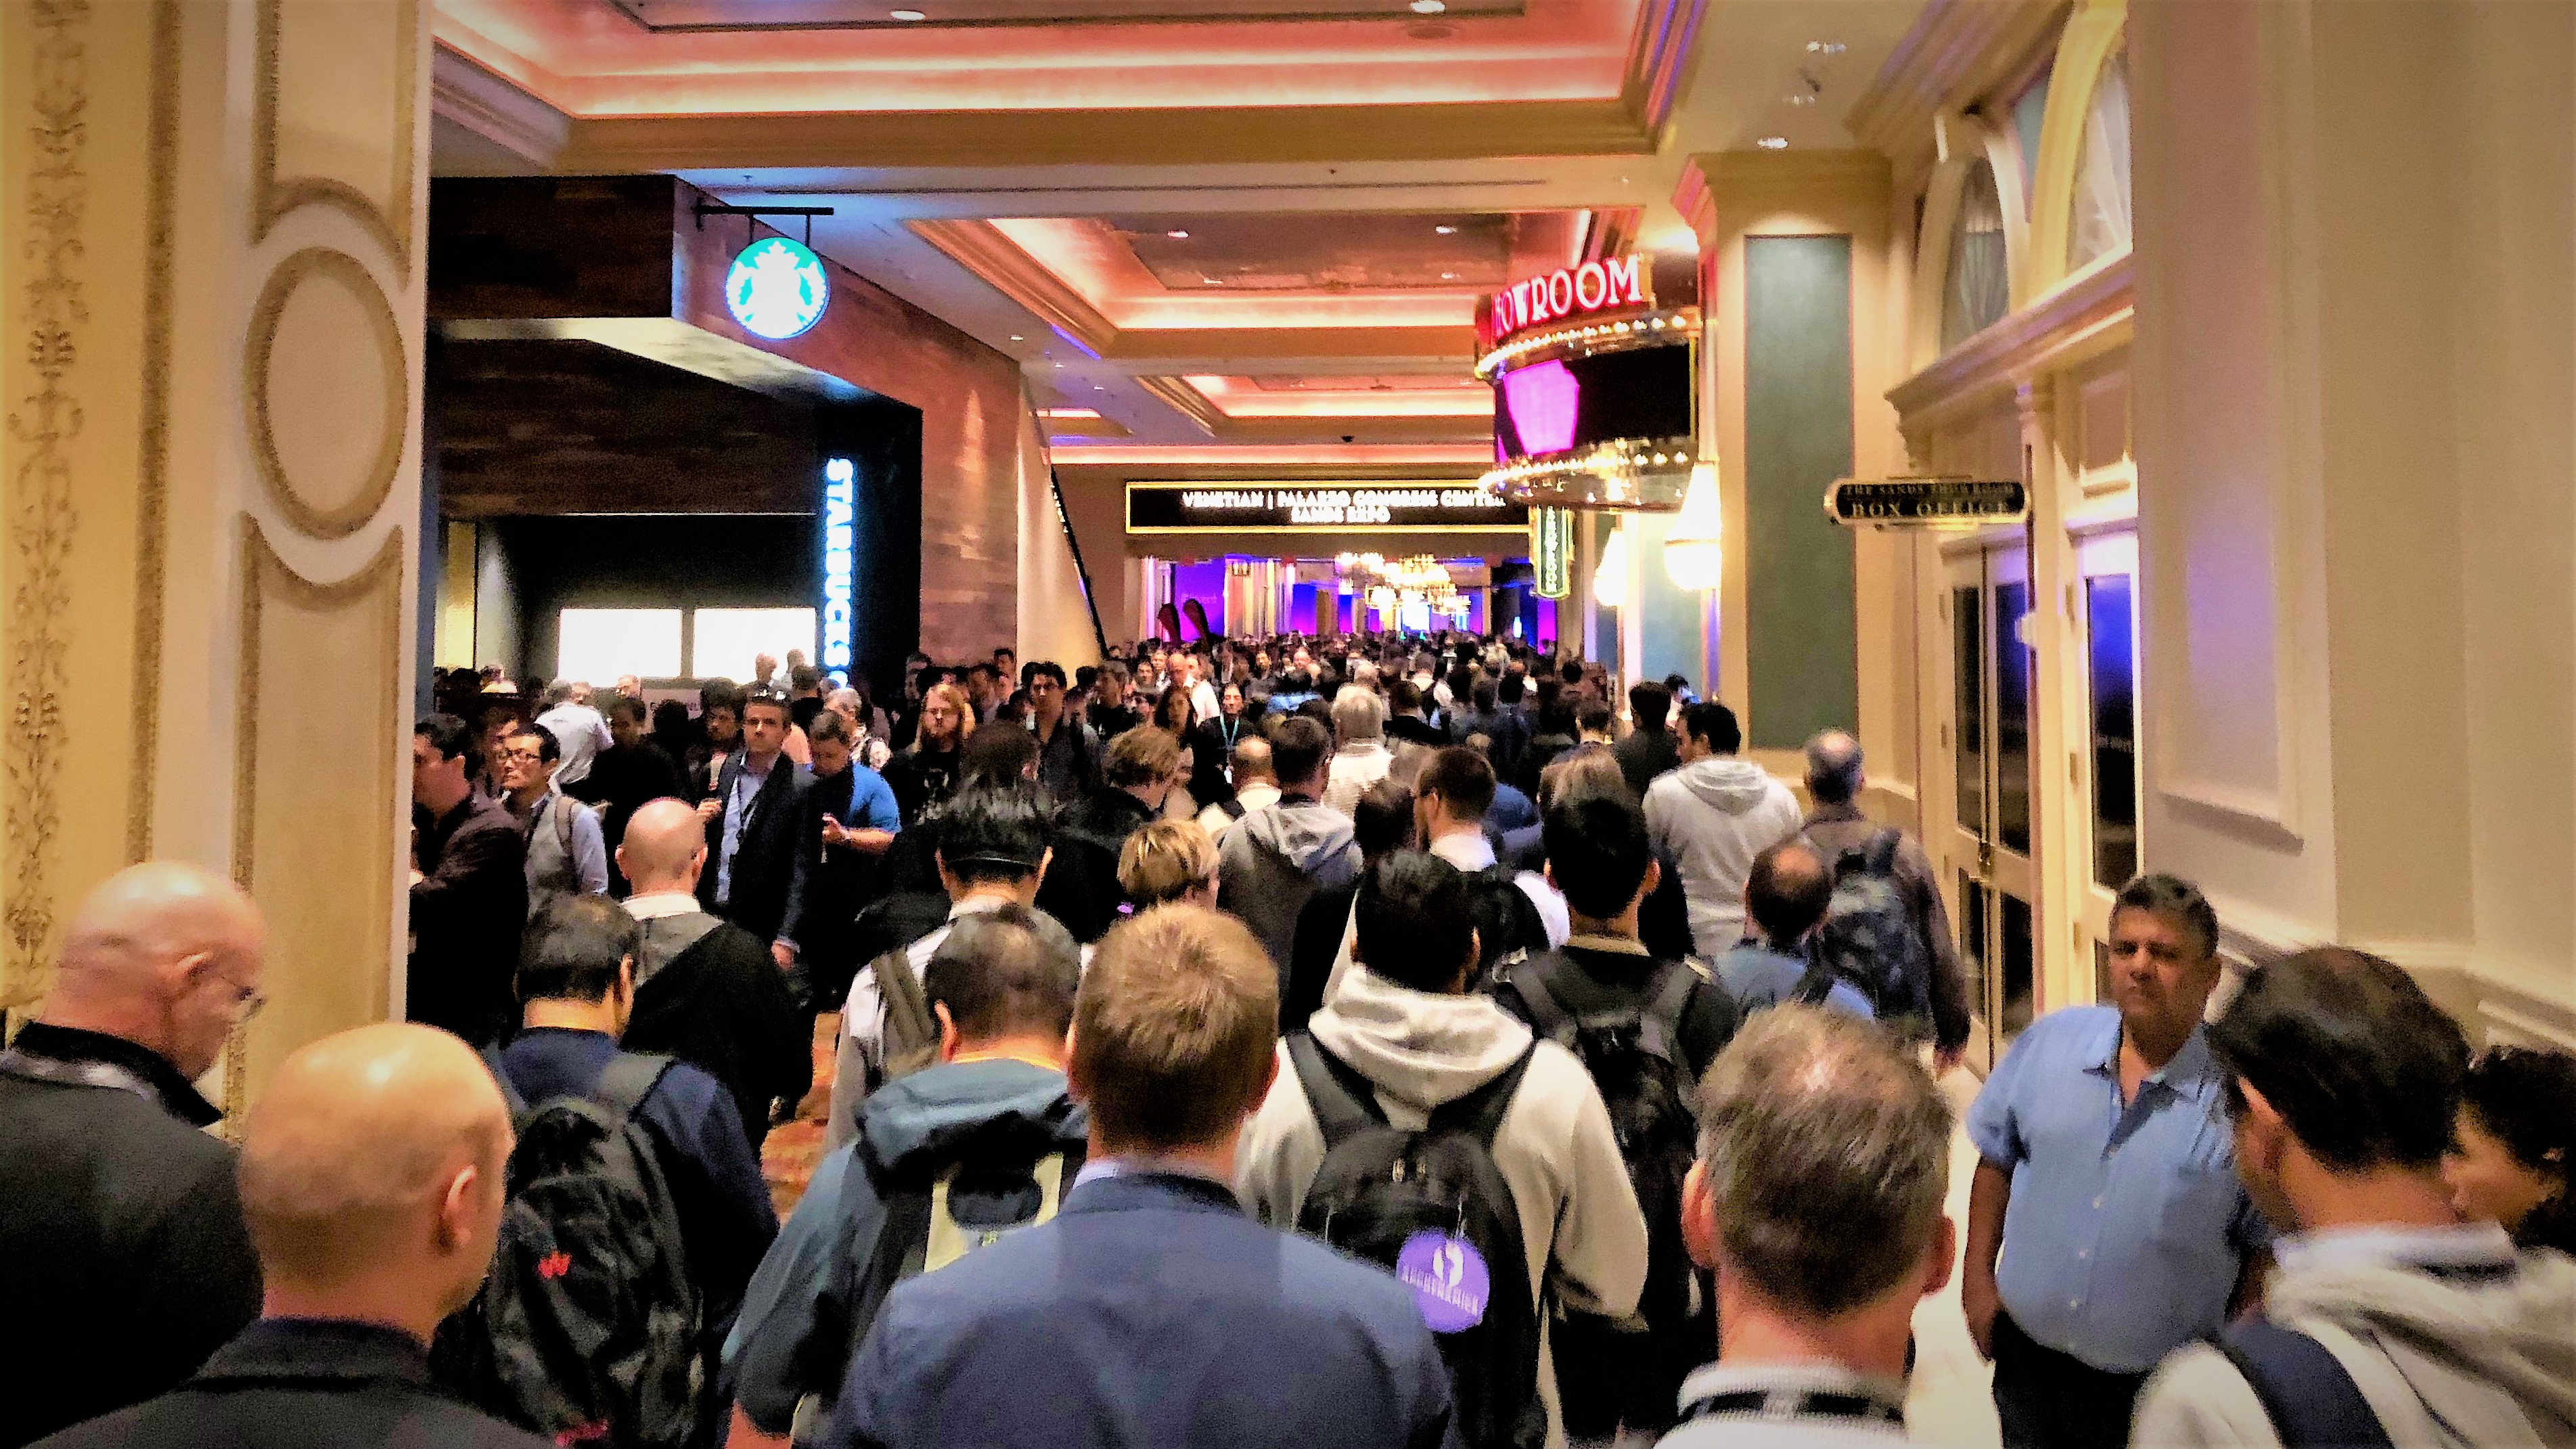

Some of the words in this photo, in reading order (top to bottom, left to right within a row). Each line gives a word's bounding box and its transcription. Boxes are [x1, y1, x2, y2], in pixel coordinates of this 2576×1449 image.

[1182, 491, 1264, 507] VENETIAN
[1277, 490, 1351, 507] PALAZZO
[1353, 489, 1439, 507] CONGRESS
[1291, 506, 1345, 522] SANDS
[1347, 506, 1391, 522] EXPO
[1852, 503, 1902, 518] BOX
[824, 458, 853, 667] STARBUCKS
